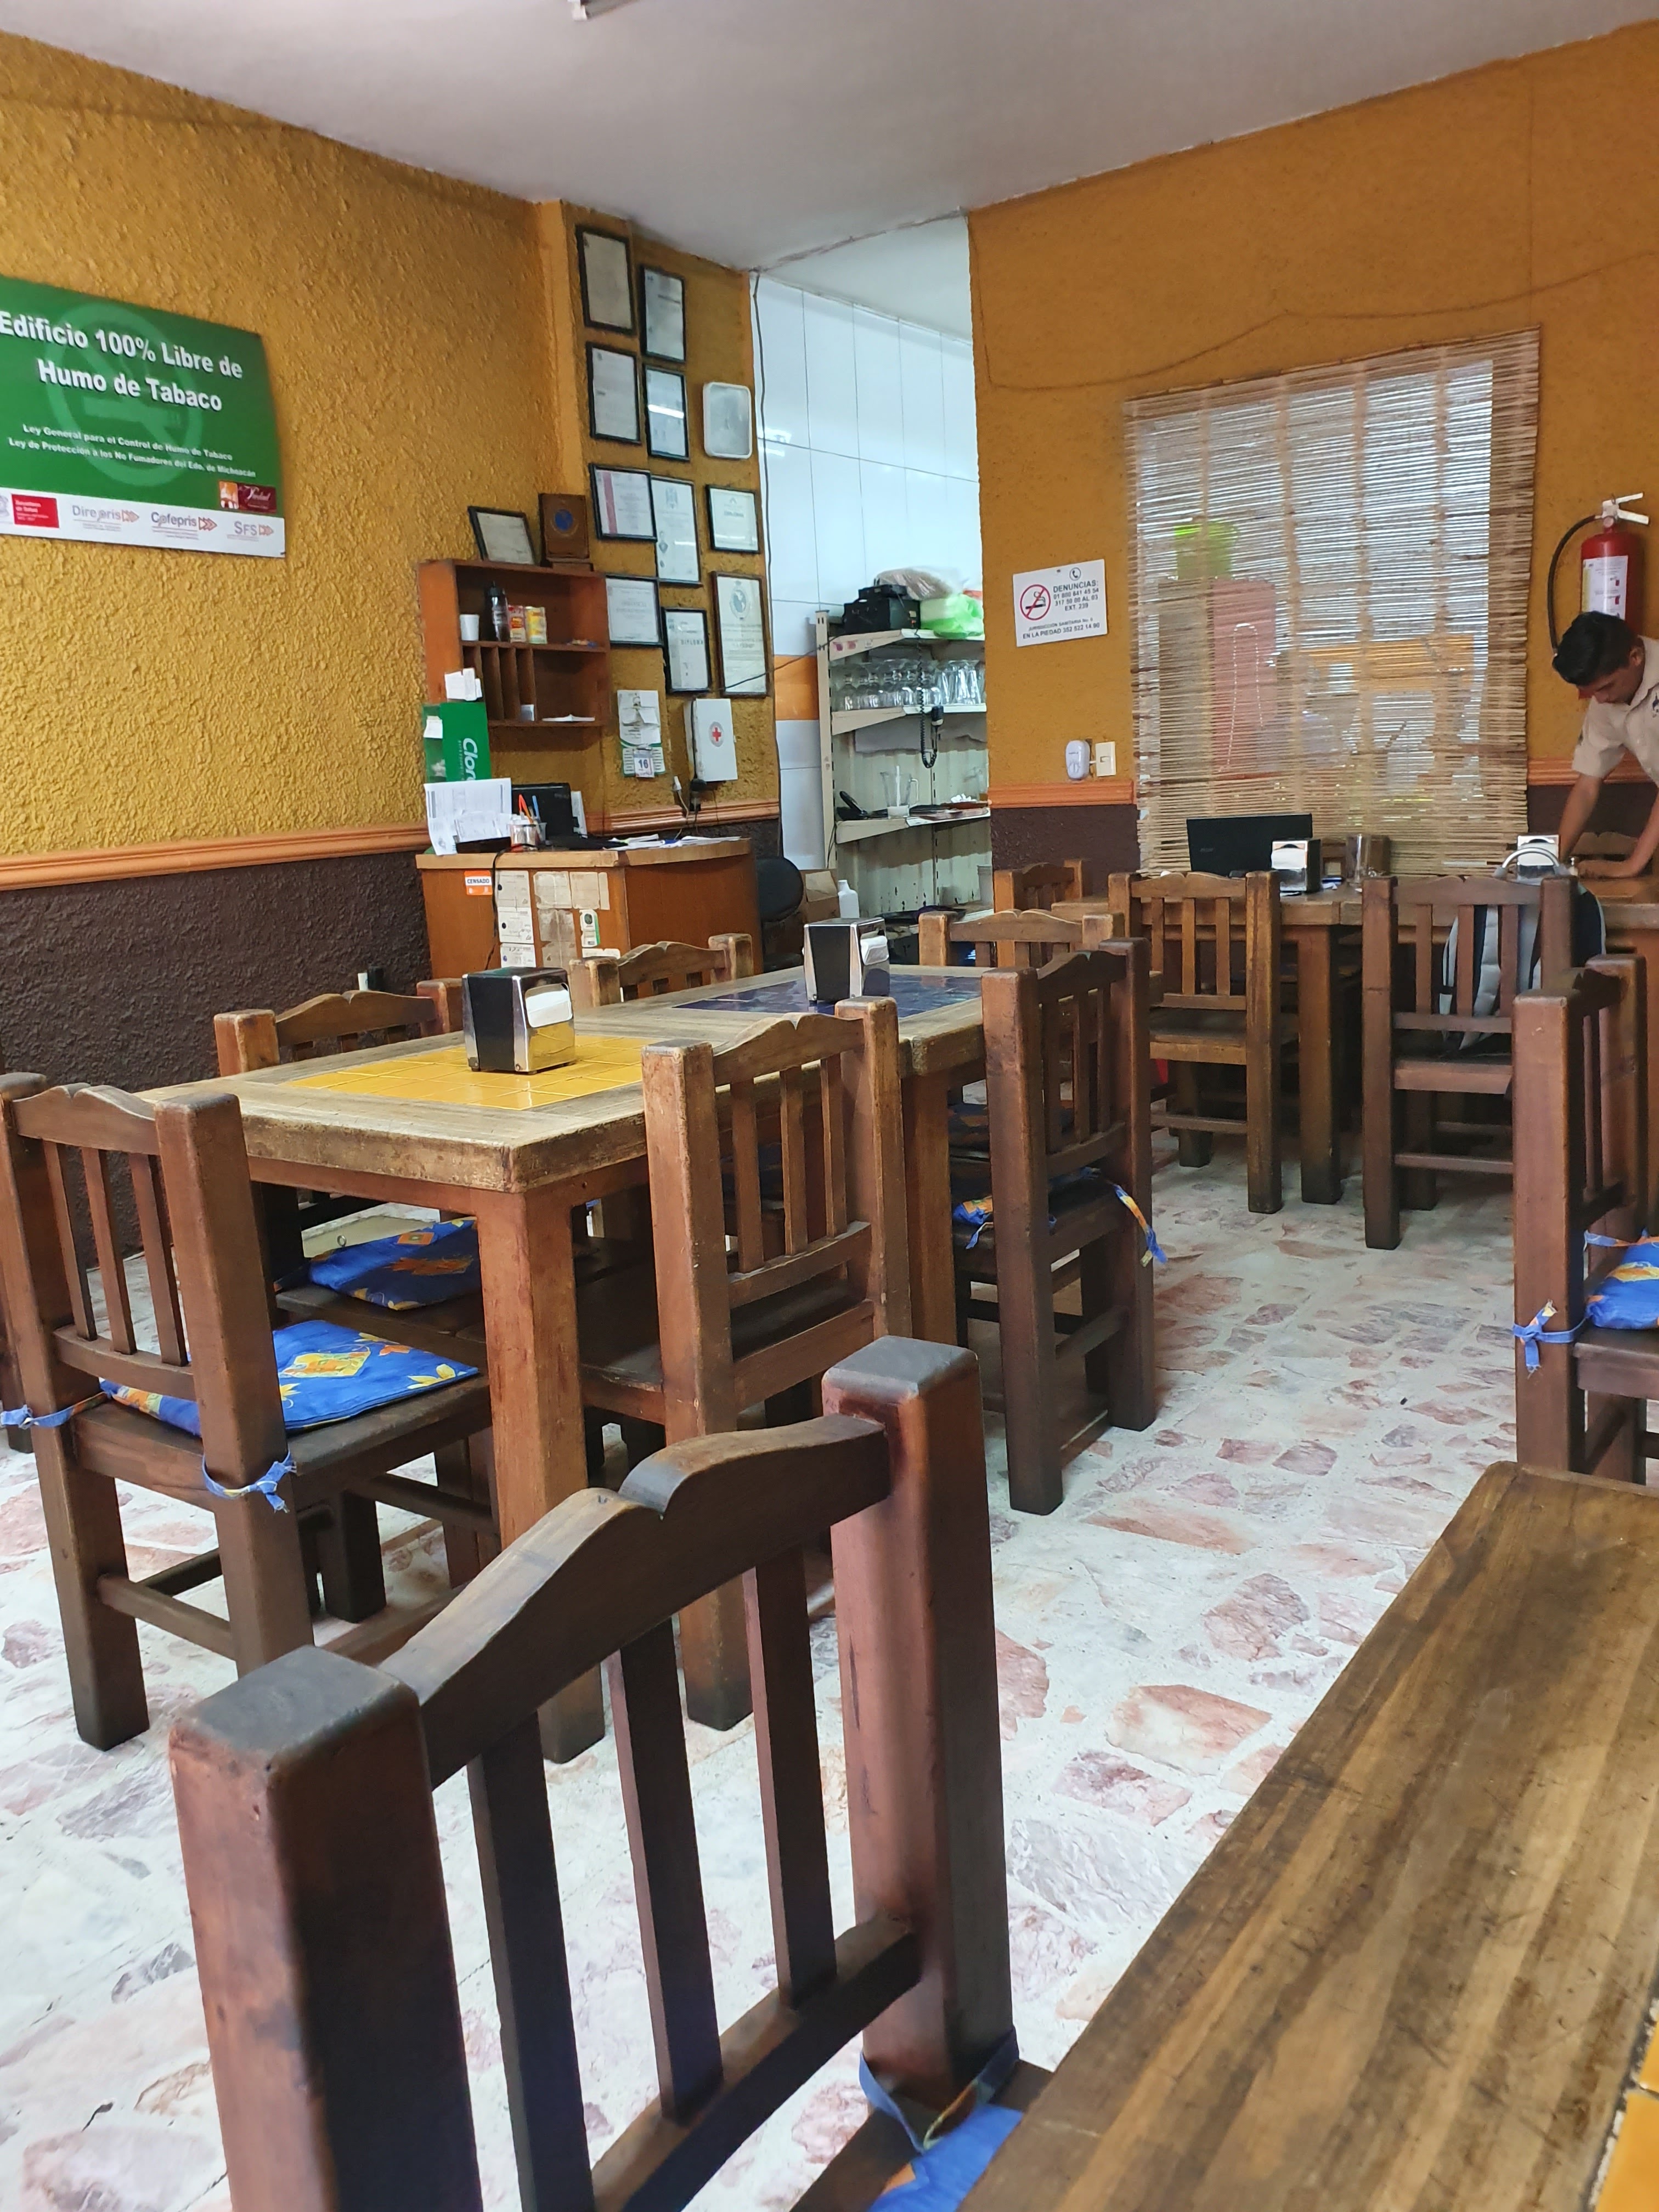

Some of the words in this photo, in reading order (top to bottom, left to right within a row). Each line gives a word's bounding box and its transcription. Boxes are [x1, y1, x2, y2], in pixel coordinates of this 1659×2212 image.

[0, 310, 88, 349] Edificio
[95, 329, 156, 363] 100%
[161, 342, 214, 373] Libre
[219, 354, 243, 379] de
[37, 358, 107, 392] Humo
[114, 373, 141, 397] de
[145, 377, 222, 411] Tabaco
[8, 437, 26, 449] Ley
[28, 440, 40, 450] de
[41, 441, 91, 456] Protección
[100, 449, 113, 459] los
[114, 451, 127, 460] No
[128, 452, 173, 467] Fumadores
[174, 460, 187, 468] del
[22, 423, 41, 436] Ley
[43, 427, 82, 439] General
[84, 433, 105, 443] para
[118, 437, 151, 449] Control
[153, 442, 163, 450] de
[165, 443, 189, 454] Humo
[191, 448, 202, 456] de
[203, 449, 233, 461] Tabaco
[151, 512, 198, 527] Cofepris
[234, 521, 258, 535] SFS
[638, 759, 648, 769] 16
